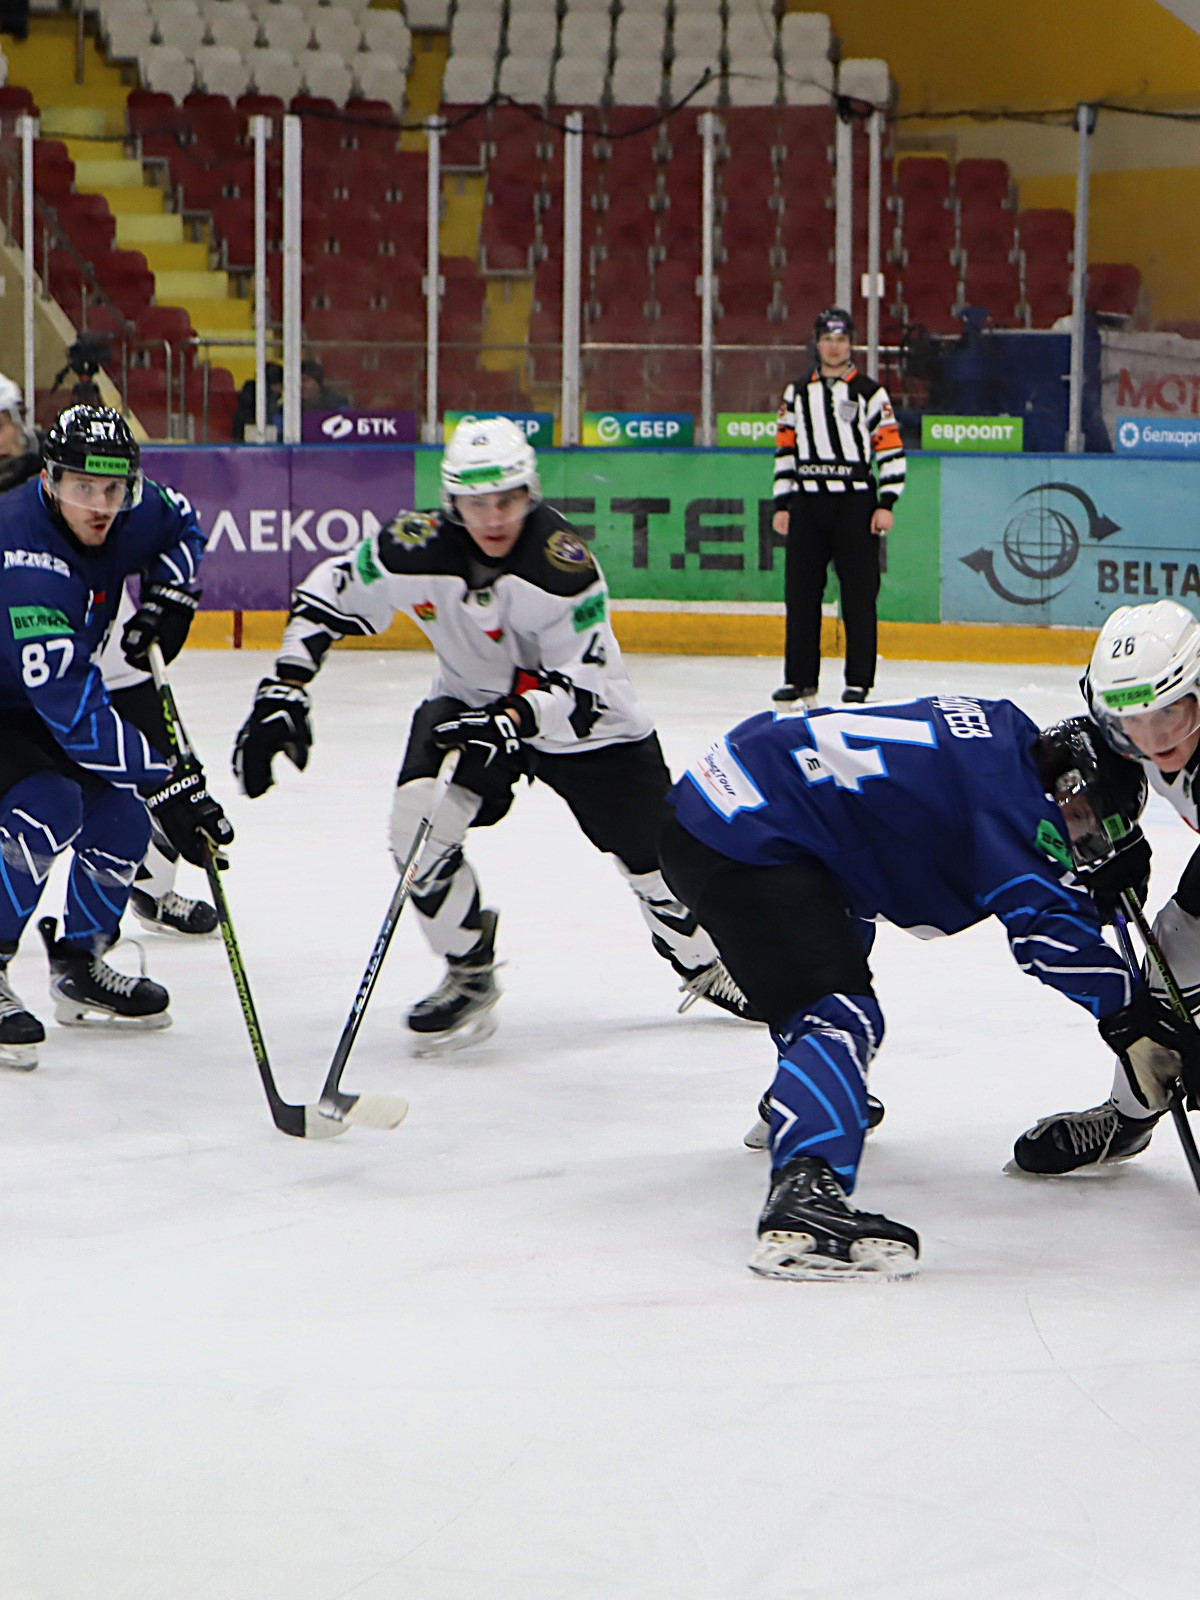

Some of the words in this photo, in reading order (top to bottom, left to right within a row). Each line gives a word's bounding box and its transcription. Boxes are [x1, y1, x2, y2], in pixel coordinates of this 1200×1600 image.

[356, 418, 398, 435] БТК
[625, 420, 681, 438] СБЕР
[727, 421, 778, 441] евро
[930, 423, 1014, 444] евроопт
[1111, 636, 1136, 659] 26
[21, 637, 75, 689] 87
